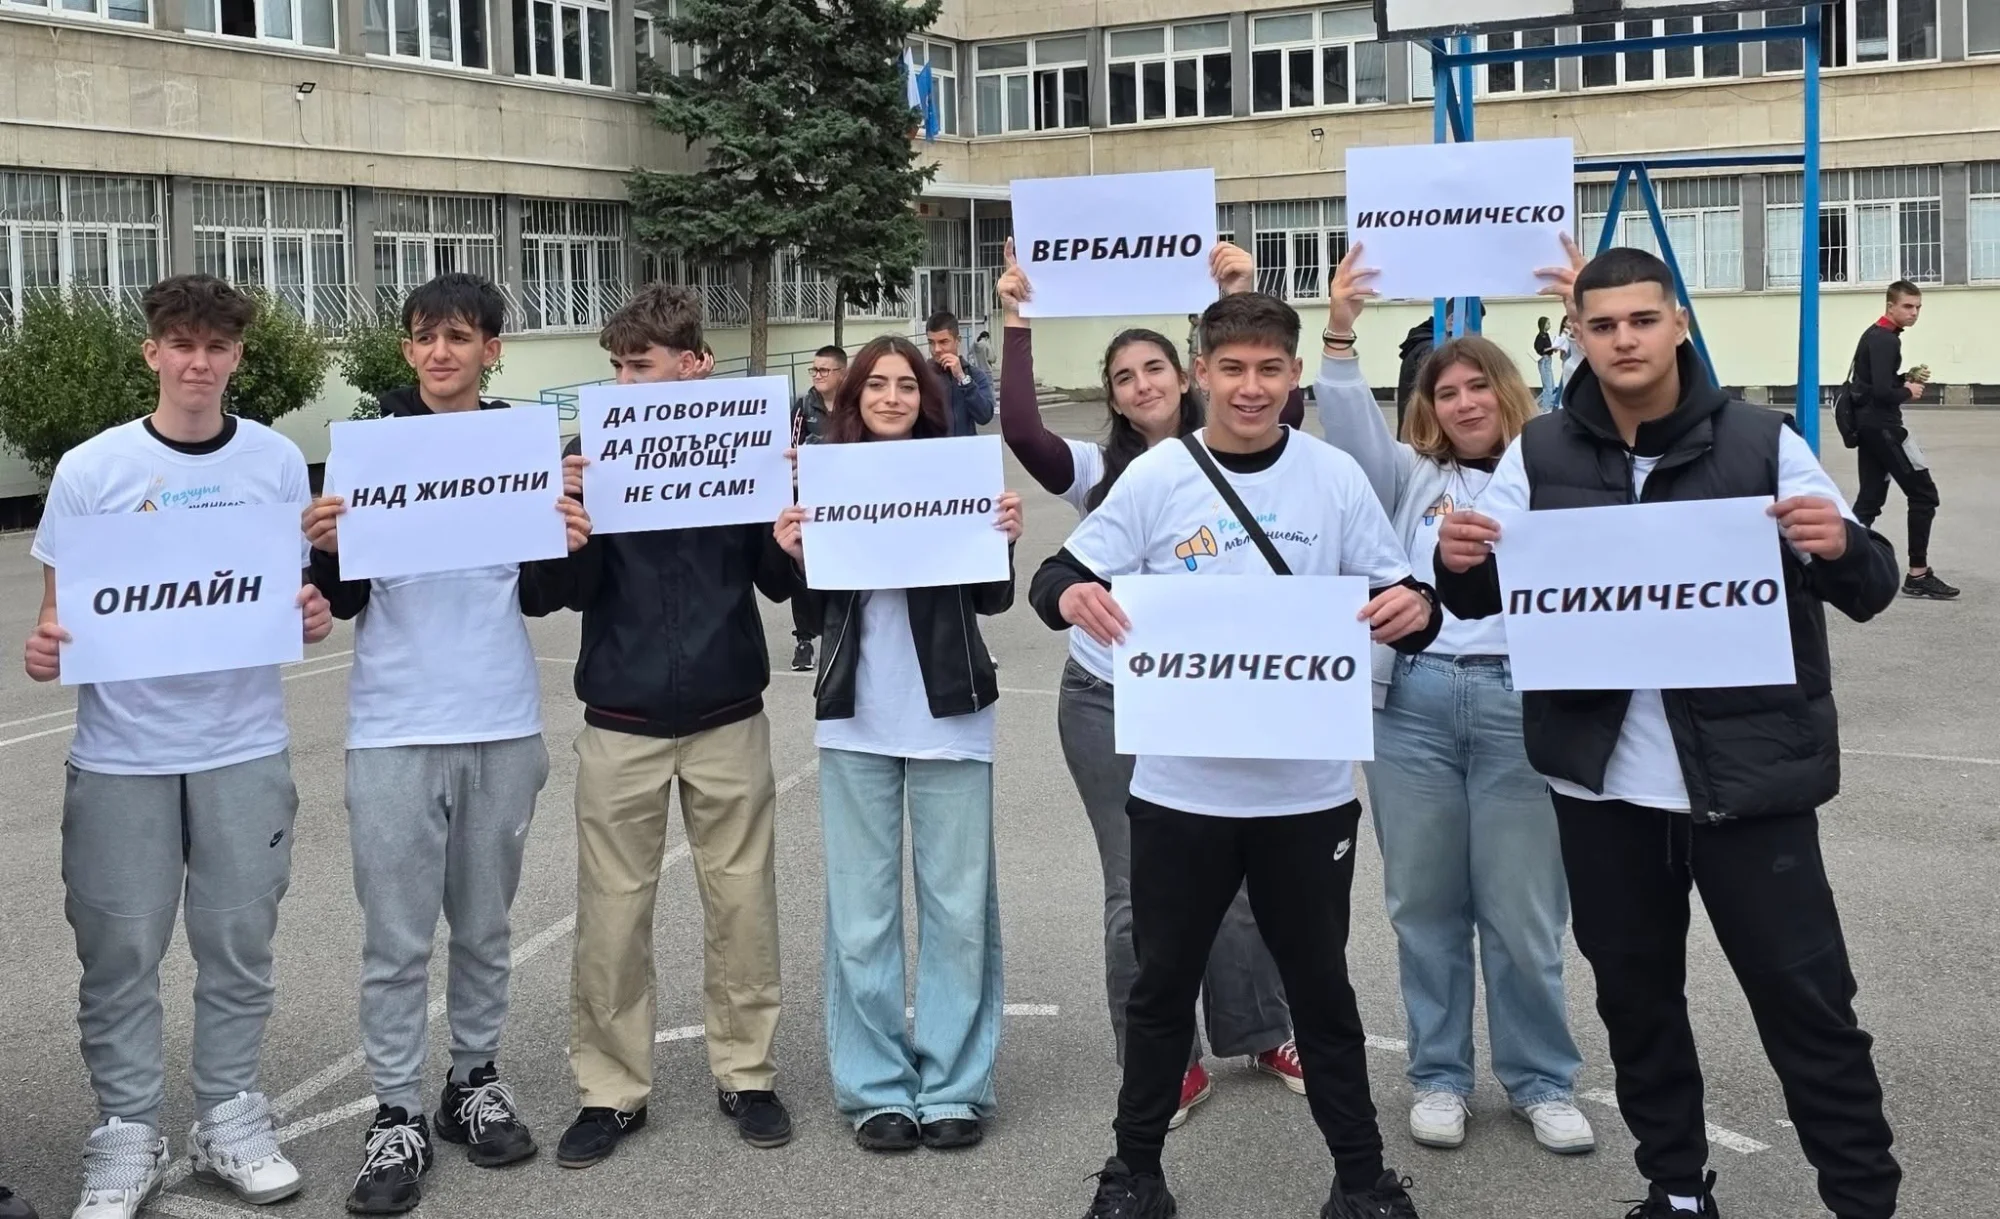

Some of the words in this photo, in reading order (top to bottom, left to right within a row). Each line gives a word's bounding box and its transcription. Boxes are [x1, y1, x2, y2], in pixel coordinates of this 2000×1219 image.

[1356, 205, 1565, 229] ИКОНОМИЧЕСКО
[1031, 233, 1202, 263] ВЕРБАЛНО
[602, 406, 636, 429] ДА
[643, 399, 767, 422] ГОВОРИШ!
[599, 438, 633, 462] ДА
[641, 430, 772, 454] ПОТЪРСИШ
[634, 448, 737, 471] ПОМОЩ!
[351, 484, 407, 510] НАД
[414, 471, 549, 502] ЖИВОТНИ
[624, 485, 654, 504] НЕ
[660, 482, 692, 501] СИ
[698, 478, 755, 498] САМ!
[814, 497, 992, 524] ЕМОЦИОНАЛНО
[93, 569, 263, 615] ОНЛАЙН
[1509, 578, 1779, 615] ПСИХИЧЕСКО
[1129, 652, 1356, 682] ФИЗИЧЕСКО
